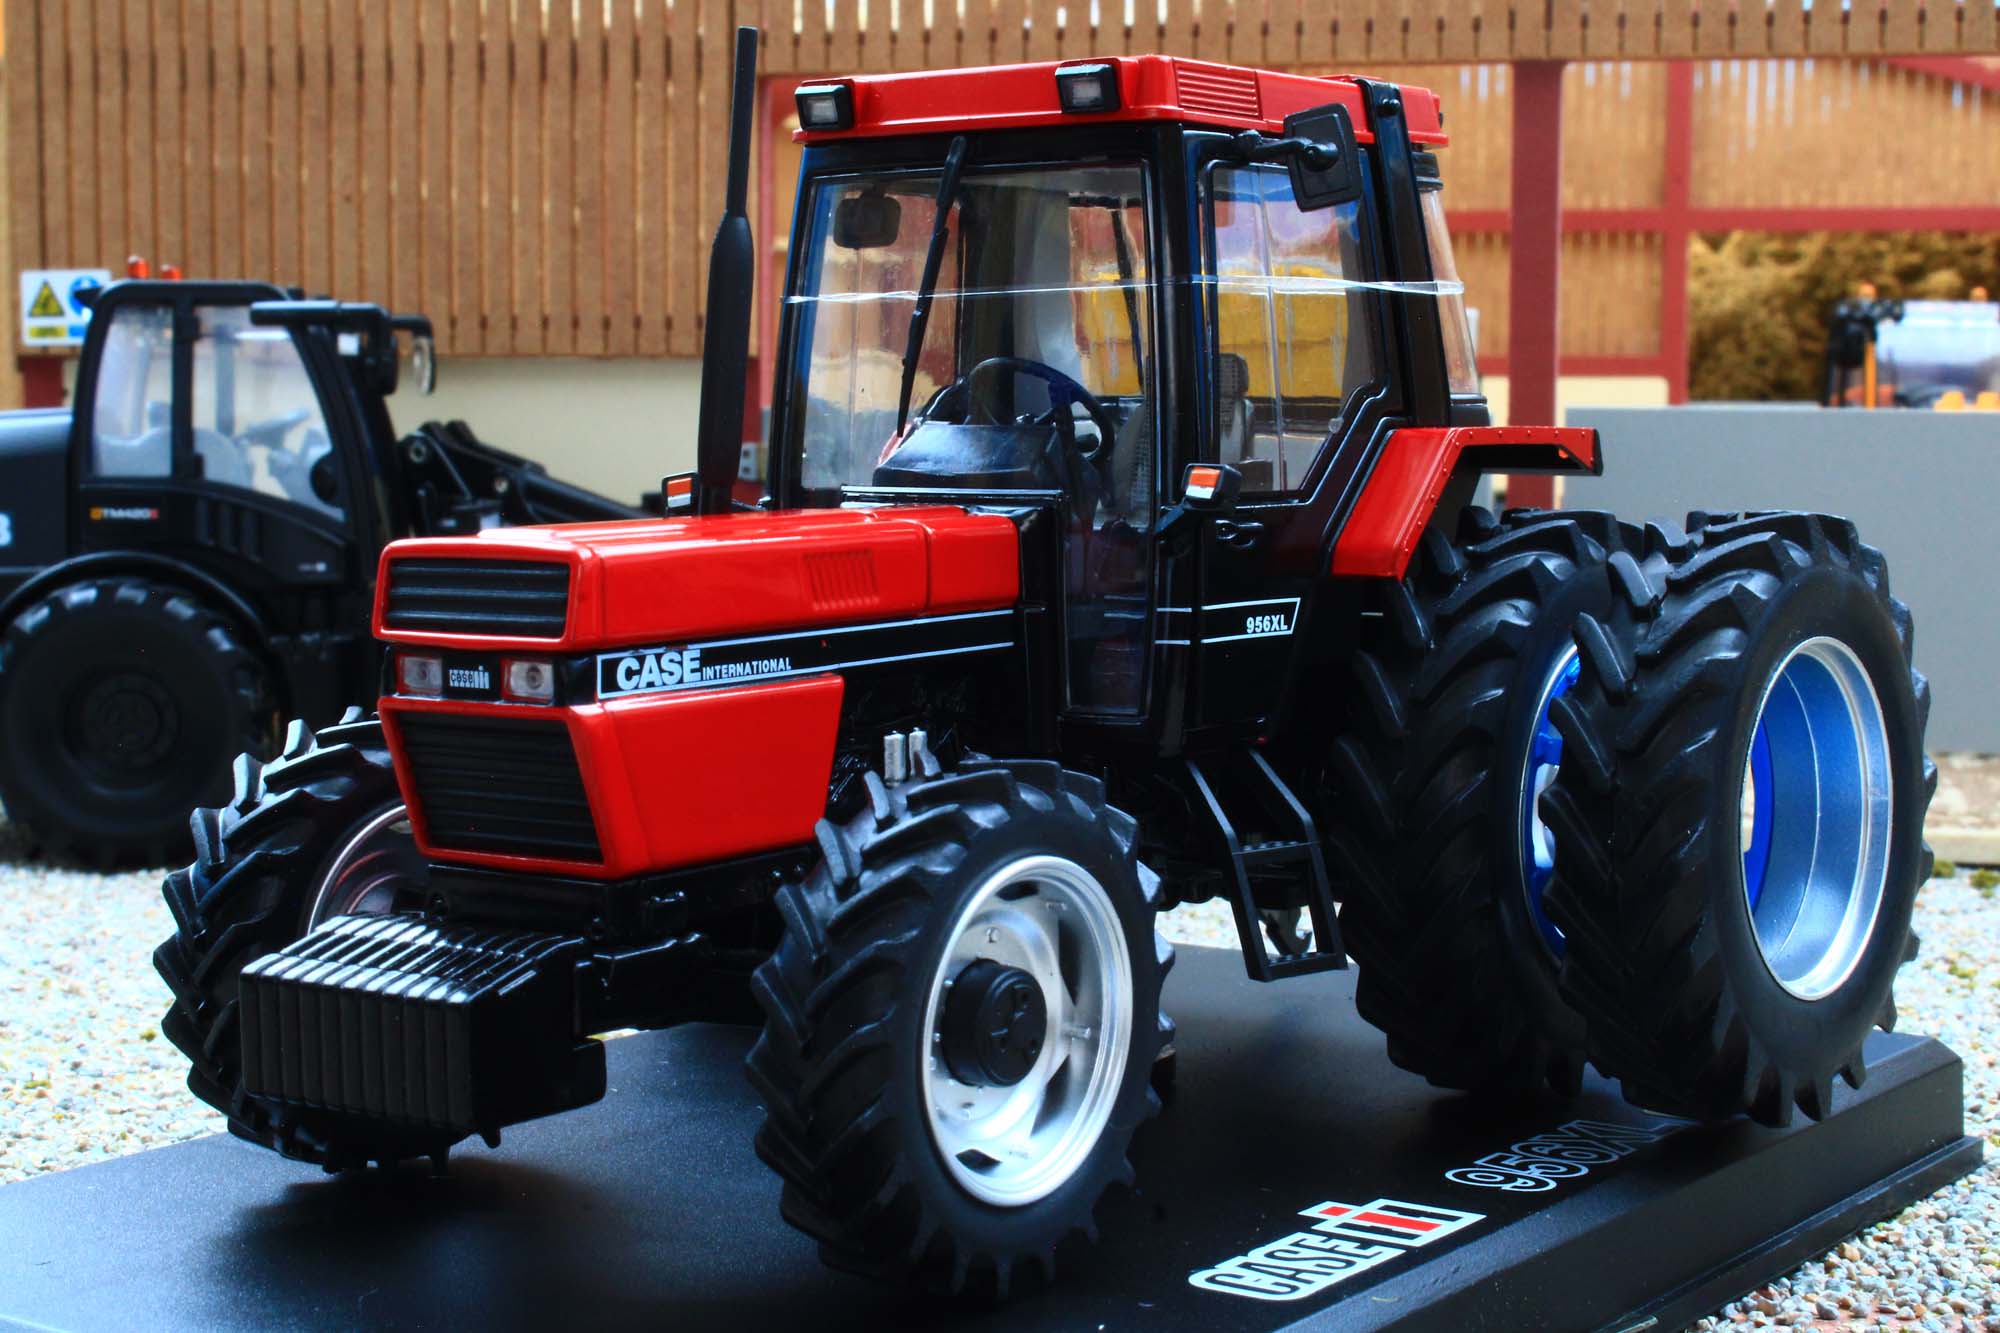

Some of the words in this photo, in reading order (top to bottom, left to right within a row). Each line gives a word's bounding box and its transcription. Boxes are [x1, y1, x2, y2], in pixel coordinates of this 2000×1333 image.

[1246, 614, 1288, 633] 956XL
[616, 649, 701, 690] CASE
[702, 657, 791, 681] INTERNATIONAL
[1188, 1232, 1406, 1300] CASE
